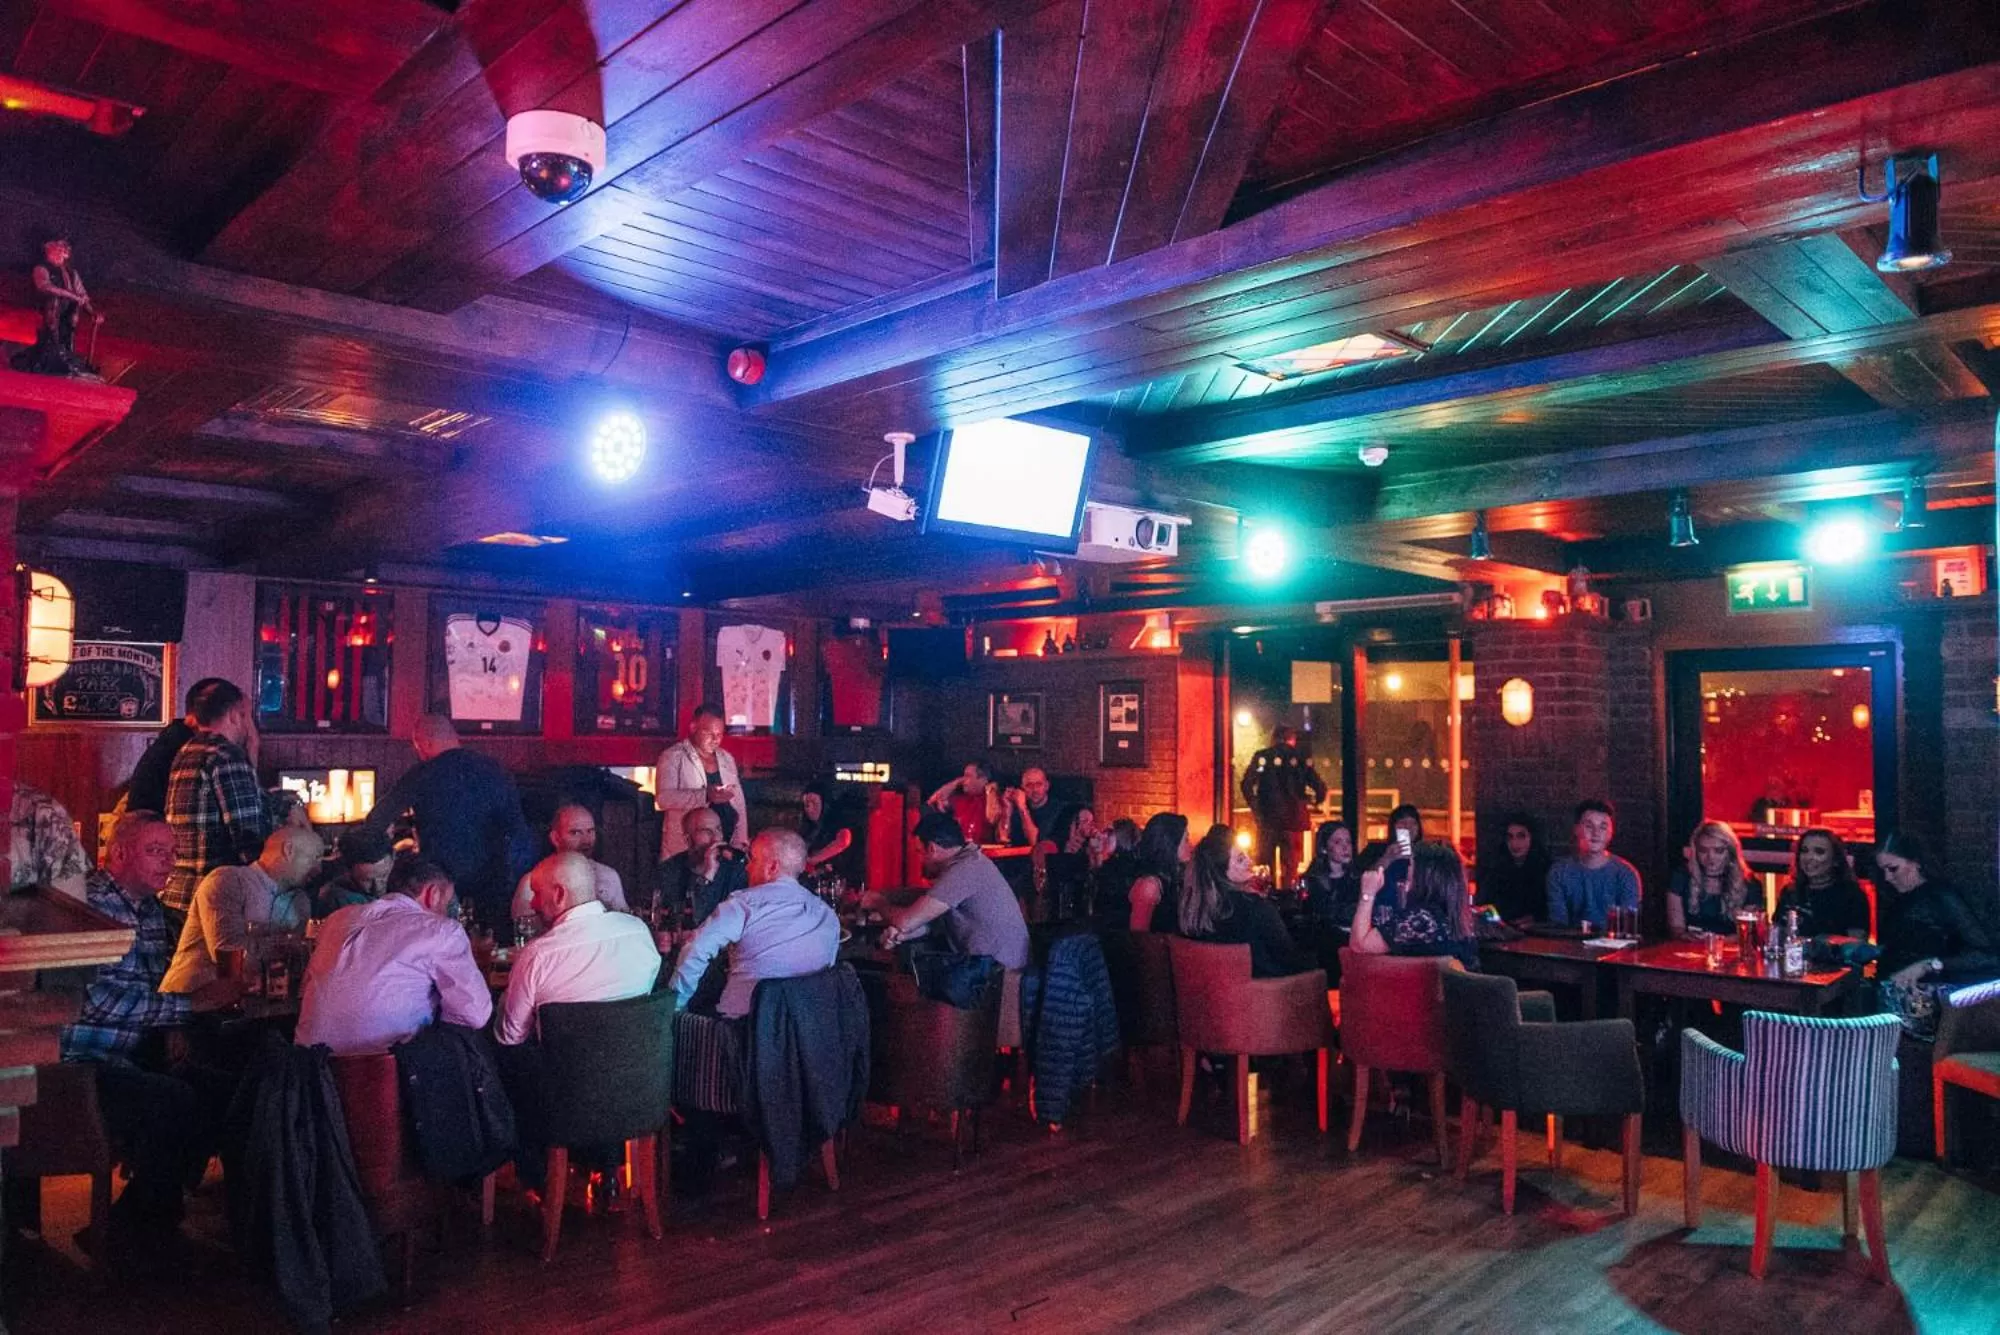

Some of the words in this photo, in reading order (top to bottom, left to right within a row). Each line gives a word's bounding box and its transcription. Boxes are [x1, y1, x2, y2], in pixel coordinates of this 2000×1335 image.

[80, 647, 92, 657] OF
[96, 646, 114, 657] THE
[118, 649, 153, 666] MONTH
[482, 656, 497, 673] 14
[614, 653, 647, 692] 10
[76, 675, 120, 691] PARK
